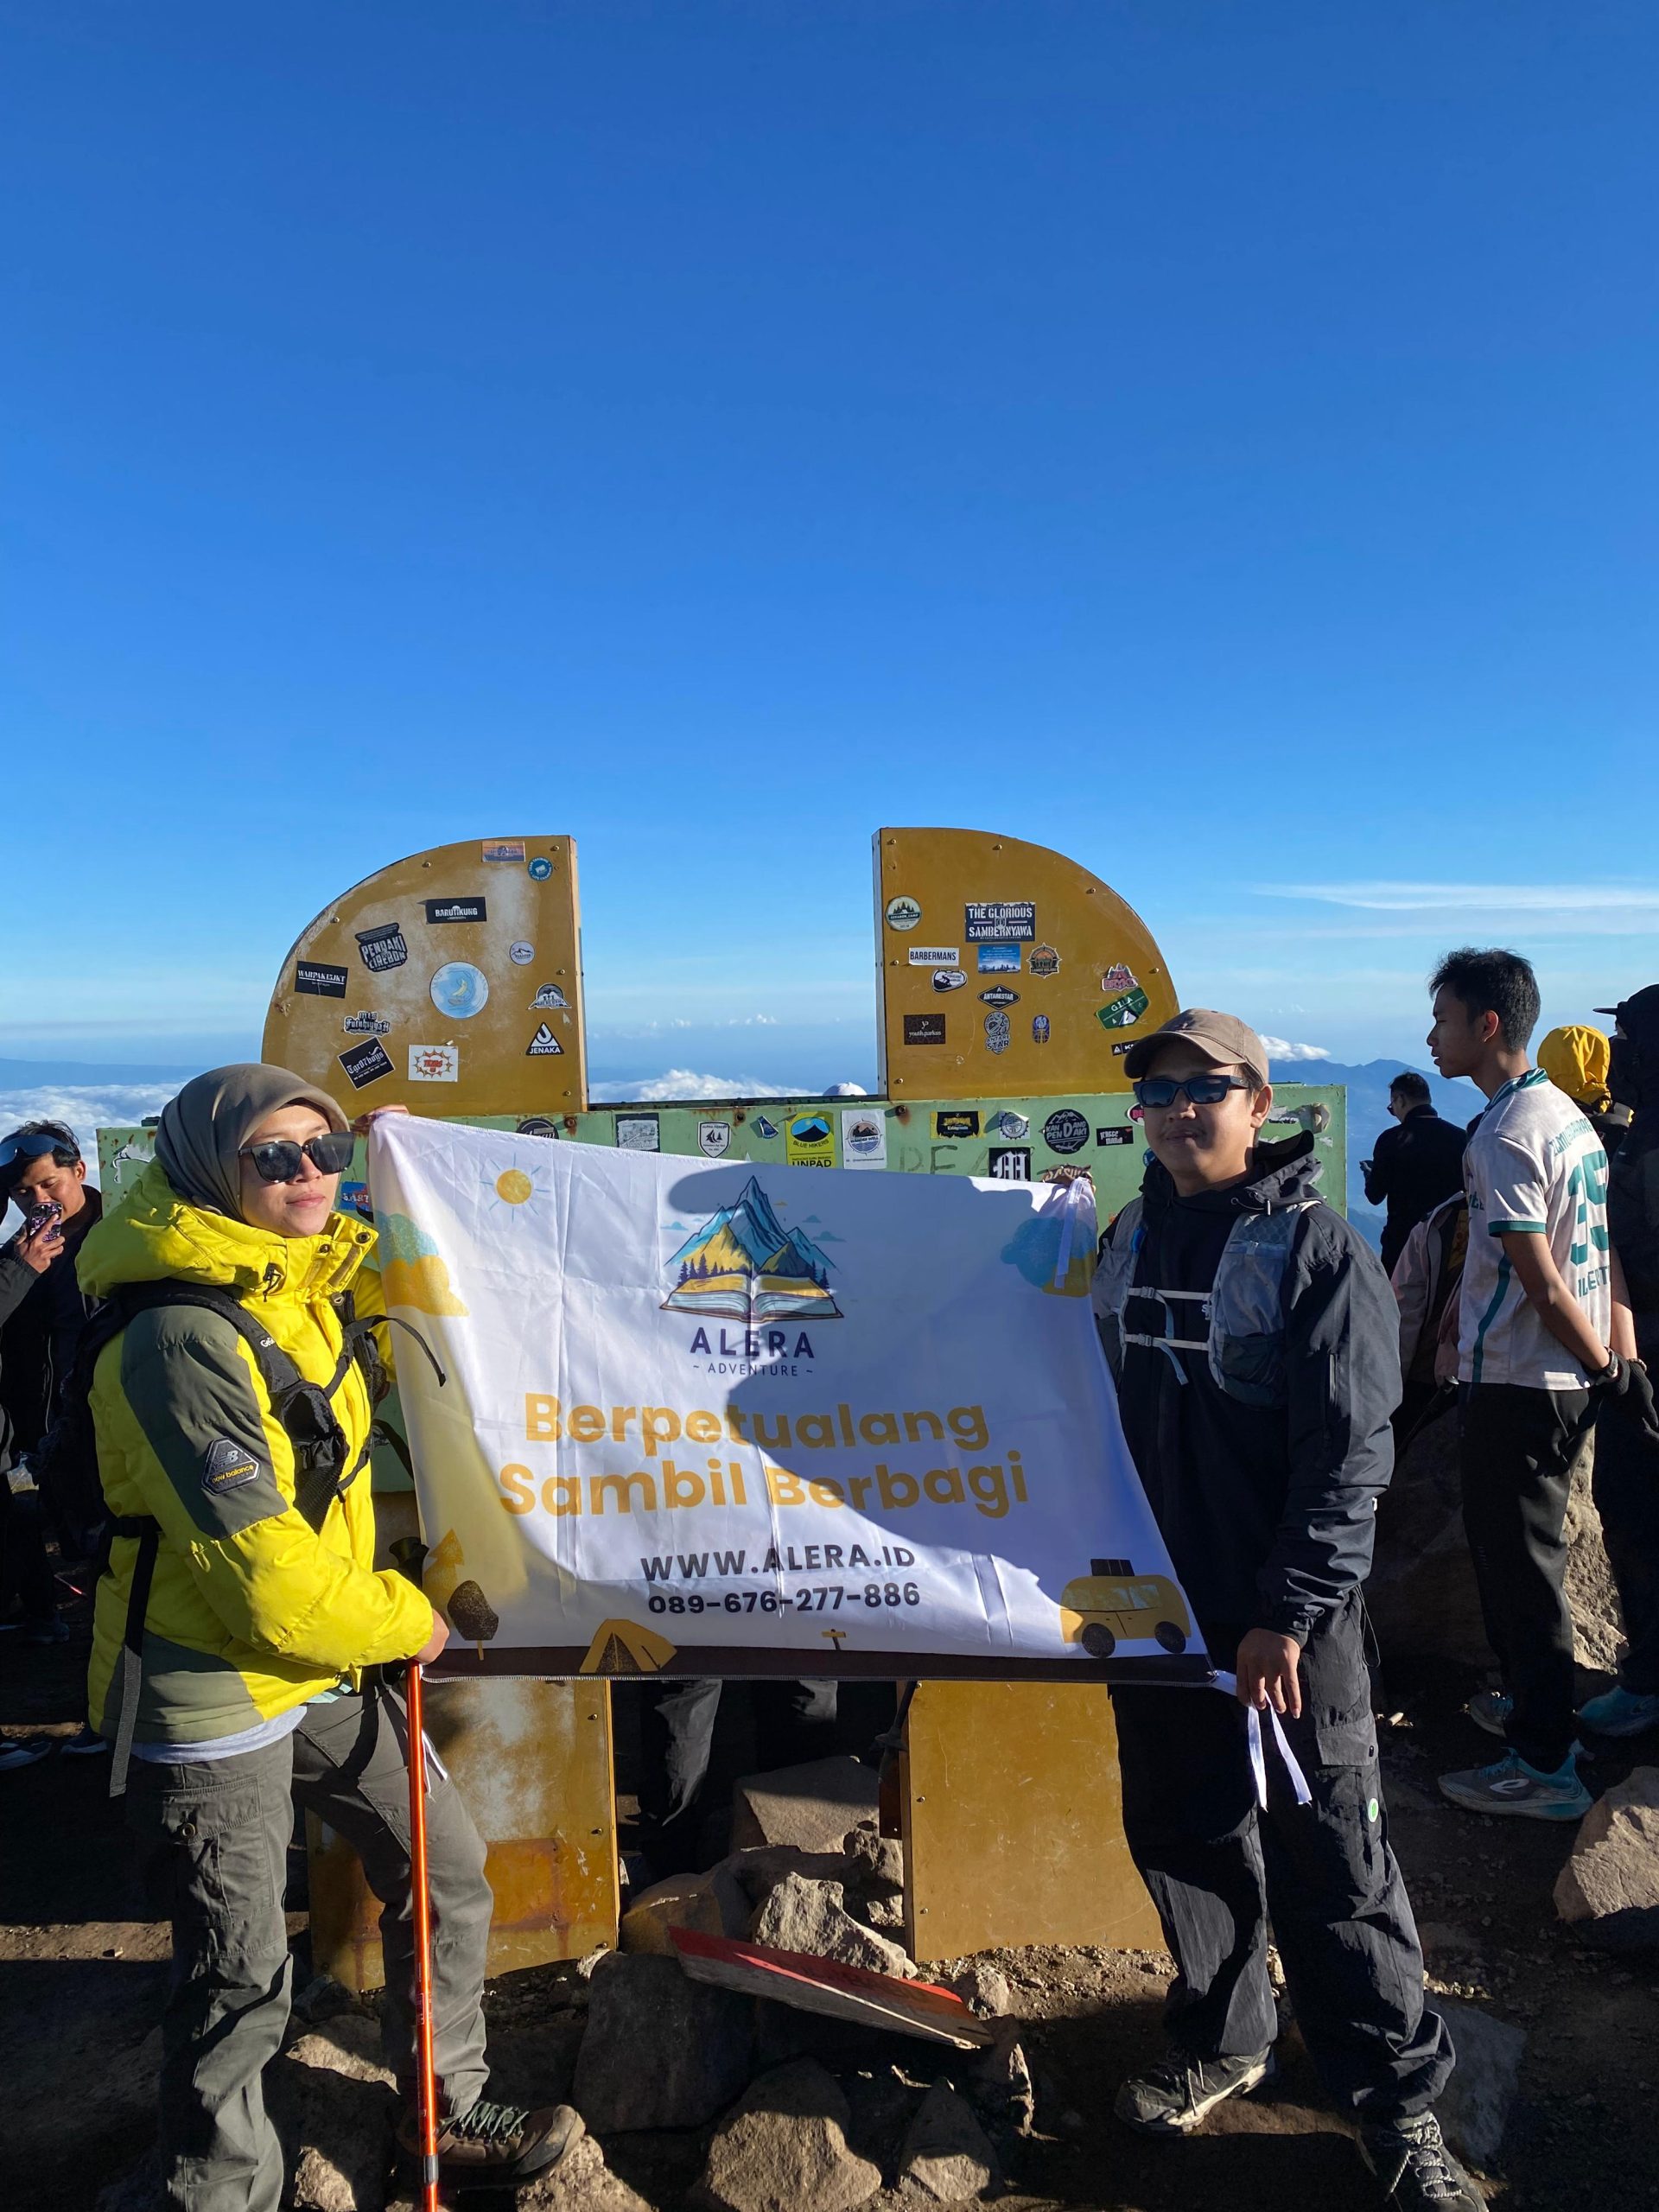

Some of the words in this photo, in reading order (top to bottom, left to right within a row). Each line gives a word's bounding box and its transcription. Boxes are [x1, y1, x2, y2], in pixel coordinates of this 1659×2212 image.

[969, 908, 986, 919] THE
[988, 907, 1033, 918] GLORIOUS
[969, 925, 1033, 938] SAMBERNYAWA
[362, 936, 405, 963] PENDAKI
[910, 951, 957, 961] BARBERMANS
[368, 952, 406, 969] CIREBON
[982, 993, 1014, 1001] ANTARESTAR
[987, 1039, 1009, 1050] STAR
[809, 1139, 830, 1148] HIKERS
[690, 1326, 815, 1359] ALERA
[707, 1363, 798, 1377] ADVENTURE
[524, 1393, 989, 1458] Berpetualang
[226, 1465, 253, 1478] balance
[499, 1459, 747, 1516] Sambil
[765, 1450, 1029, 1519] Berbagi
[641, 1544, 916, 1582] WWW.ALERA.ID
[648, 1582, 921, 1614] 089-676-277-886
